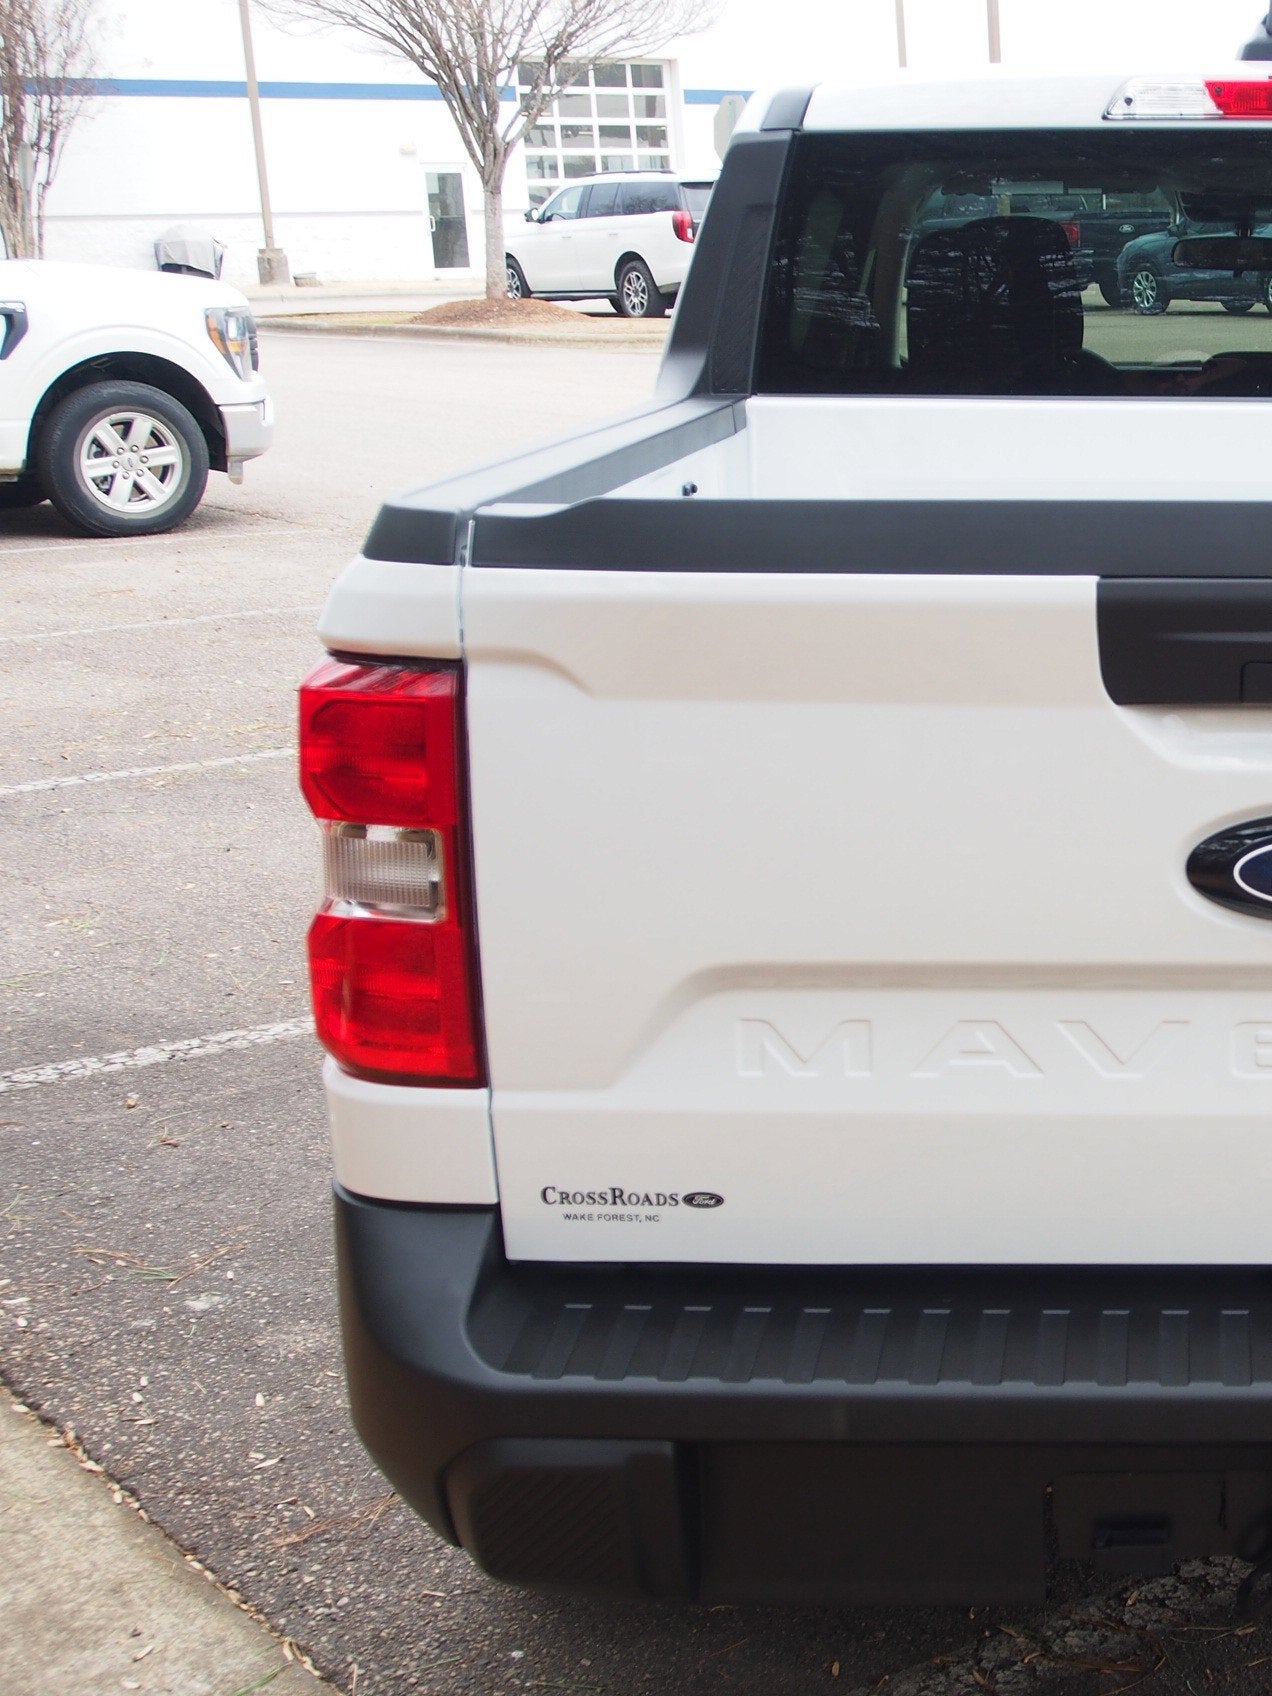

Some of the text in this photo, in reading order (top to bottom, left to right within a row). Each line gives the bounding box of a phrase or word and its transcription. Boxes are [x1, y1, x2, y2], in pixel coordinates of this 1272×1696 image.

[563, 1213, 660, 1223] WAKE FOREST, NC
